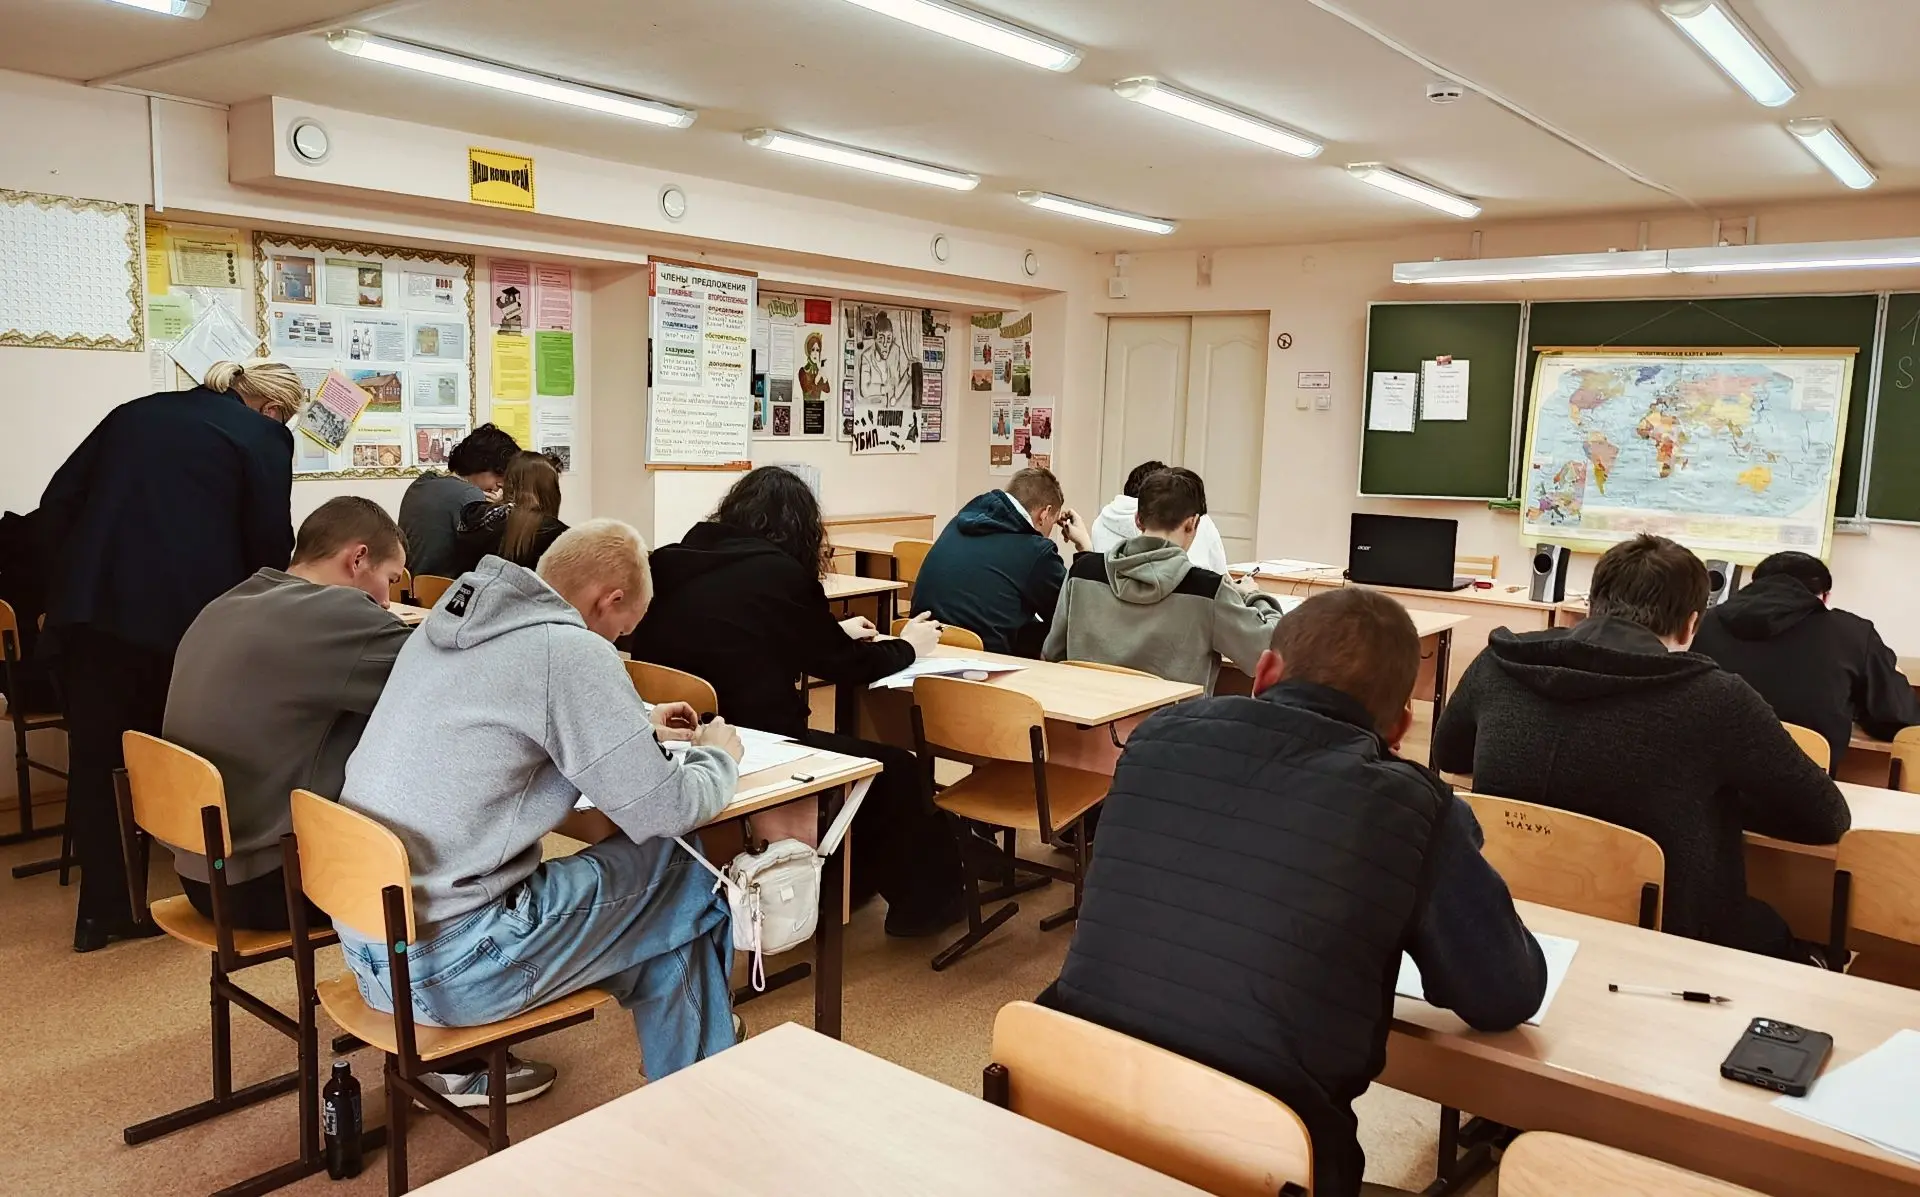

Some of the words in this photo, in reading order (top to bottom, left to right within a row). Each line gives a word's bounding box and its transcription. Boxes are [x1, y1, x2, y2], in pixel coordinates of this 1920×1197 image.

[472, 160, 489, 185] НАШ
[490, 167, 511, 184] КОМИ
[511, 164, 530, 193] КРАЙ
[660, 272, 689, 284] ЧЛЕНЫ
[691, 277, 747, 292] ПРЕДЛОЖЕНИЯ
[668, 288, 693, 298] ГЛАВНЫЕ
[662, 320, 699, 330] подлежащее
[665, 346, 695, 355] сказуемое
